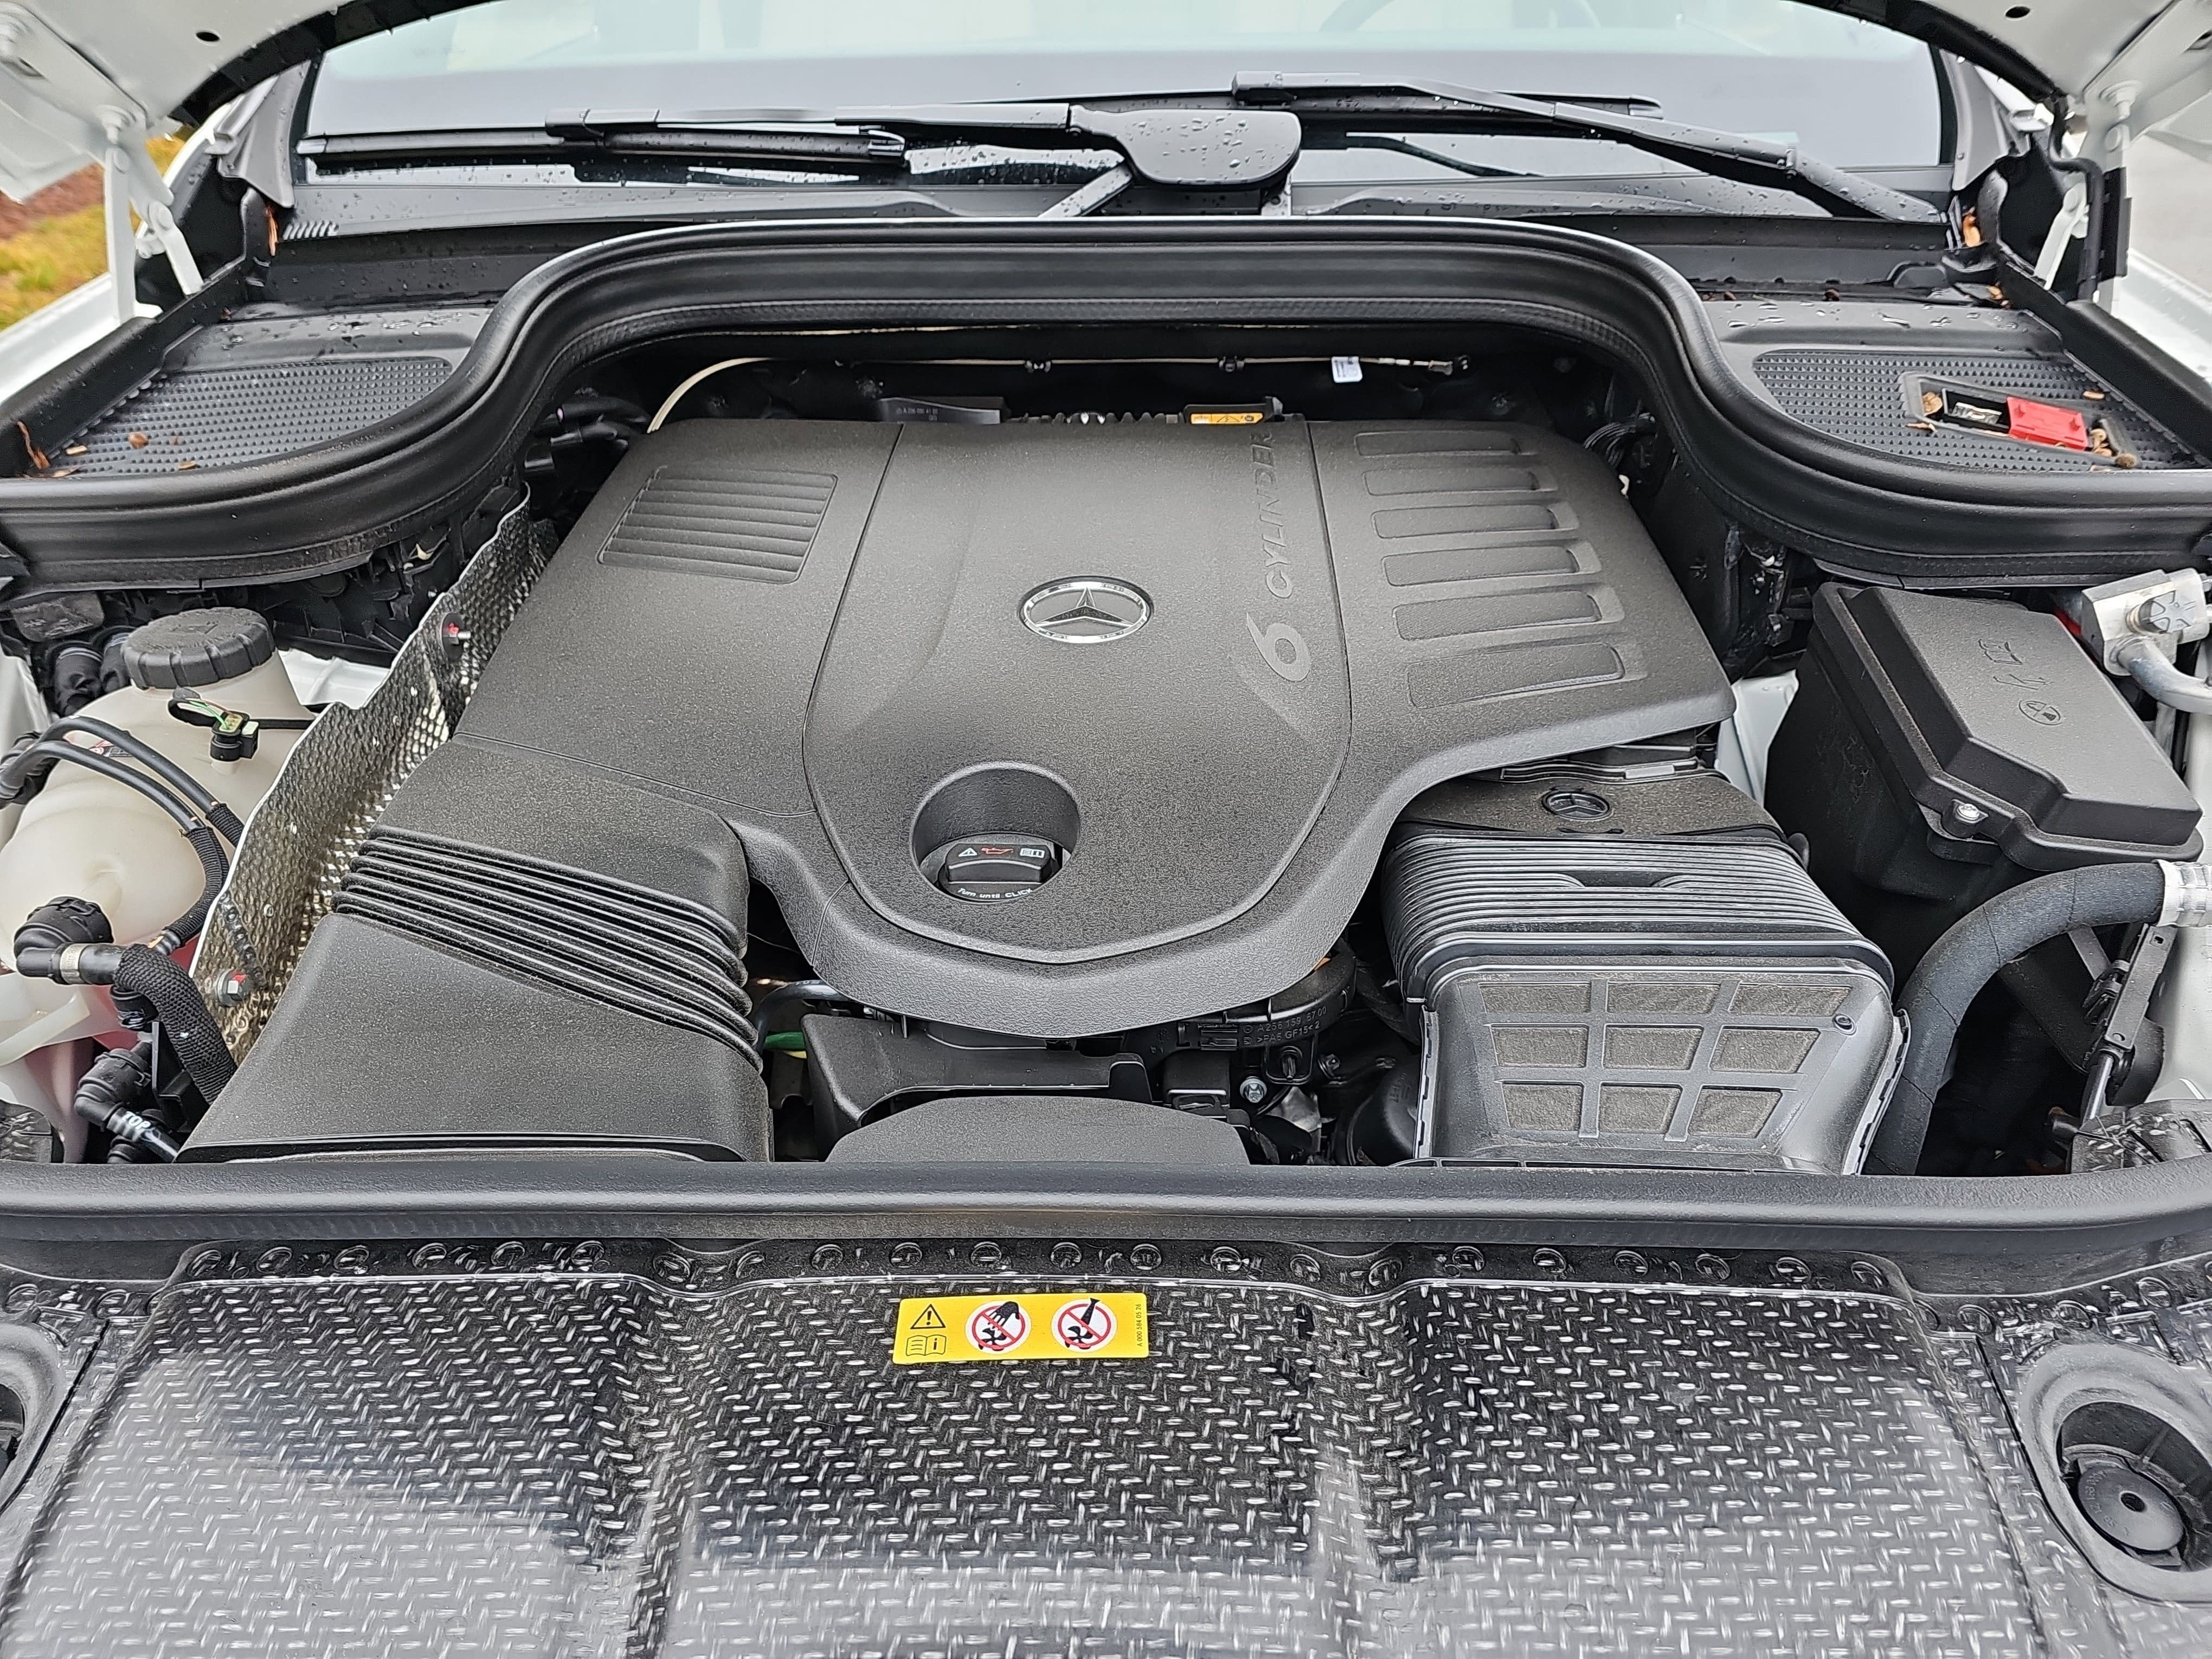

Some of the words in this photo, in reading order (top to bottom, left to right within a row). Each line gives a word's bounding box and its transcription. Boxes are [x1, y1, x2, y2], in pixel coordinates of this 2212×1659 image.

[1249, 428, 1294, 599] CYLINDER
[1246, 610, 1310, 683] 6
[957, 887, 976, 897] Turn
[1005, 888, 1033, 898] CLICK
[121, 1110, 151, 1130] TOP
